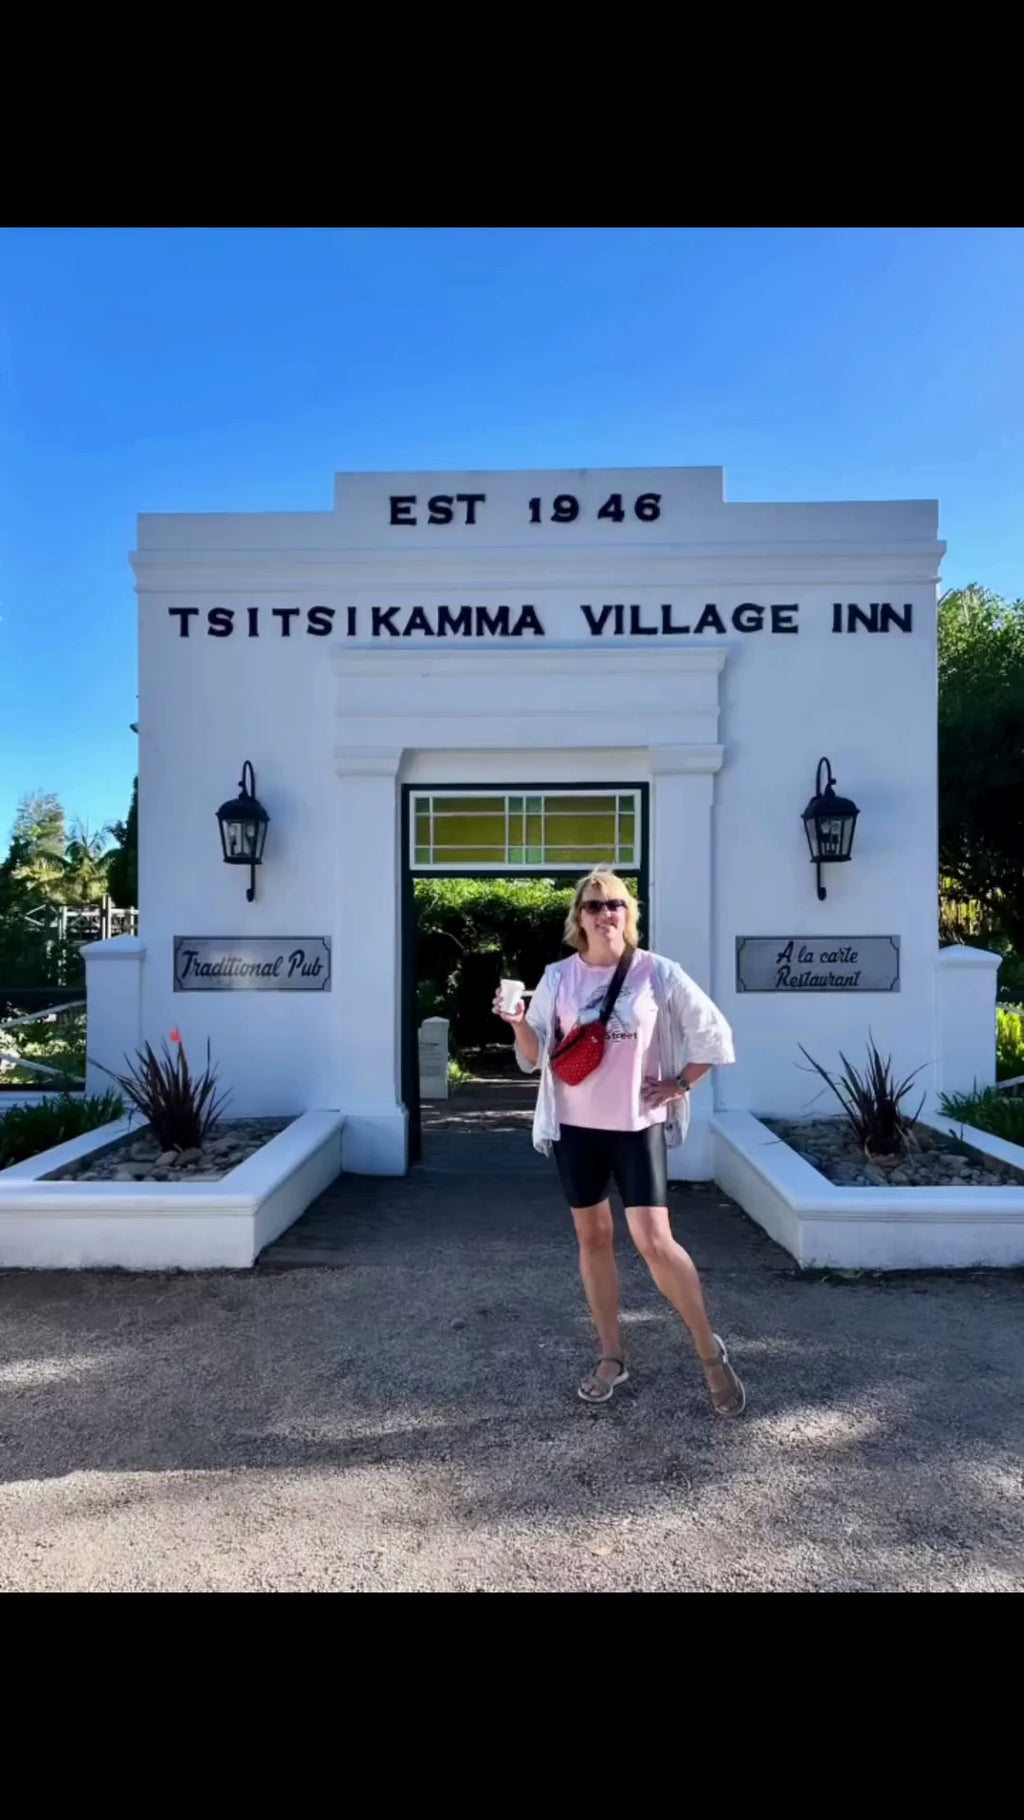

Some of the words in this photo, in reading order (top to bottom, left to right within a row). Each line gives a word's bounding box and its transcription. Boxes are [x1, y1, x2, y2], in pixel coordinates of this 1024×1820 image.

[388, 493, 487, 526] EST
[528, 492, 663, 523] 1946
[168, 604, 546, 638] TSITSIKAMMA
[580, 602, 799, 636] VILLAGE
[831, 602, 913, 634] INN
[182, 950, 284, 979] Traditional
[288, 949, 324, 978] Pub
[775, 940, 794, 964] A
[798, 945, 814, 964] la
[819, 946, 859, 964] carte
[774, 964, 862, 988] Restaurant
